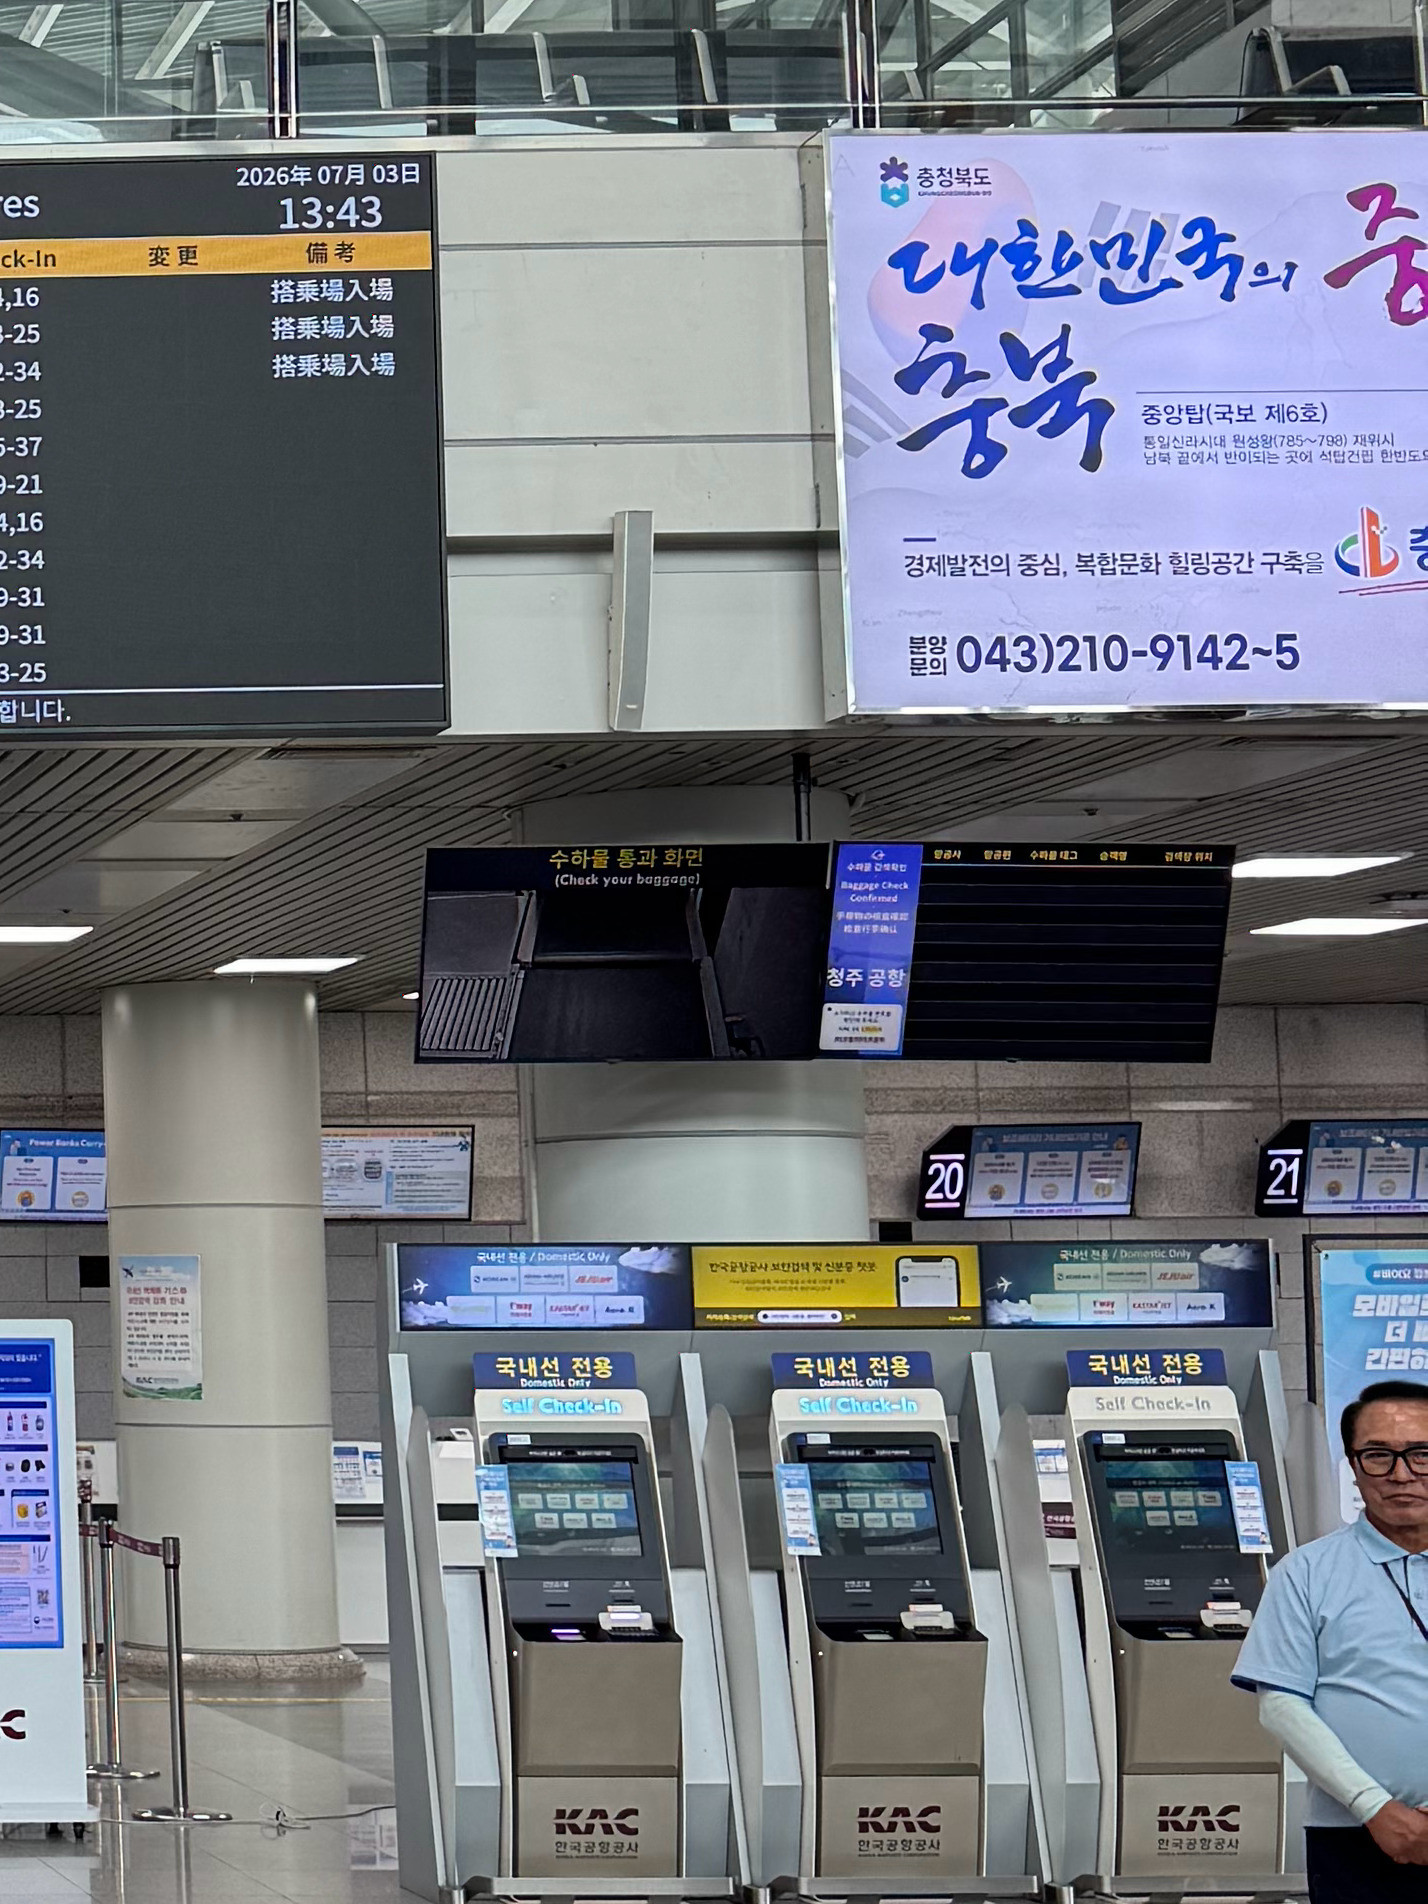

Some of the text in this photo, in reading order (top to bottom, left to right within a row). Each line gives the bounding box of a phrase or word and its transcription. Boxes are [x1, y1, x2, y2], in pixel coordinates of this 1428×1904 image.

[236, 162, 420, 187] 2026年 07月 03日
[916, 166, 992, 189] 충청북도
[279, 195, 383, 230] 13:43
[305, 240, 356, 264] 備考
[886, 214, 1300, 312] 대한민국의
[892, 323, 1116, 480] 충북
[1141, 401, 1328, 426] 중앙탑(국보 제6호)
[904, 550, 1325, 578] 경제발전의 중심, 복합문화 힐링공간 구축을
[956, 633, 1300, 674] 043)210-9142~5
[549, 847, 703, 870] 수하물 통과 화면
[554, 873, 701, 888] (Check your baggage)
[826, 967, 907, 988] 청주 공항
[925, 1162, 964, 1201] 20
[1265, 1156, 1301, 1197] 21
[494, 1356, 613, 1379] 국내선 전용
[520, 1378, 565, 1389] Domestic
[501, 1397, 623, 1414] Self Check-In
[552, 1806, 640, 1837] KAC
[856, 1804, 943, 1834] KAC
[1155, 1803, 1242, 1833] KAC
[552, 1840, 640, 1855] 한국공항공사
